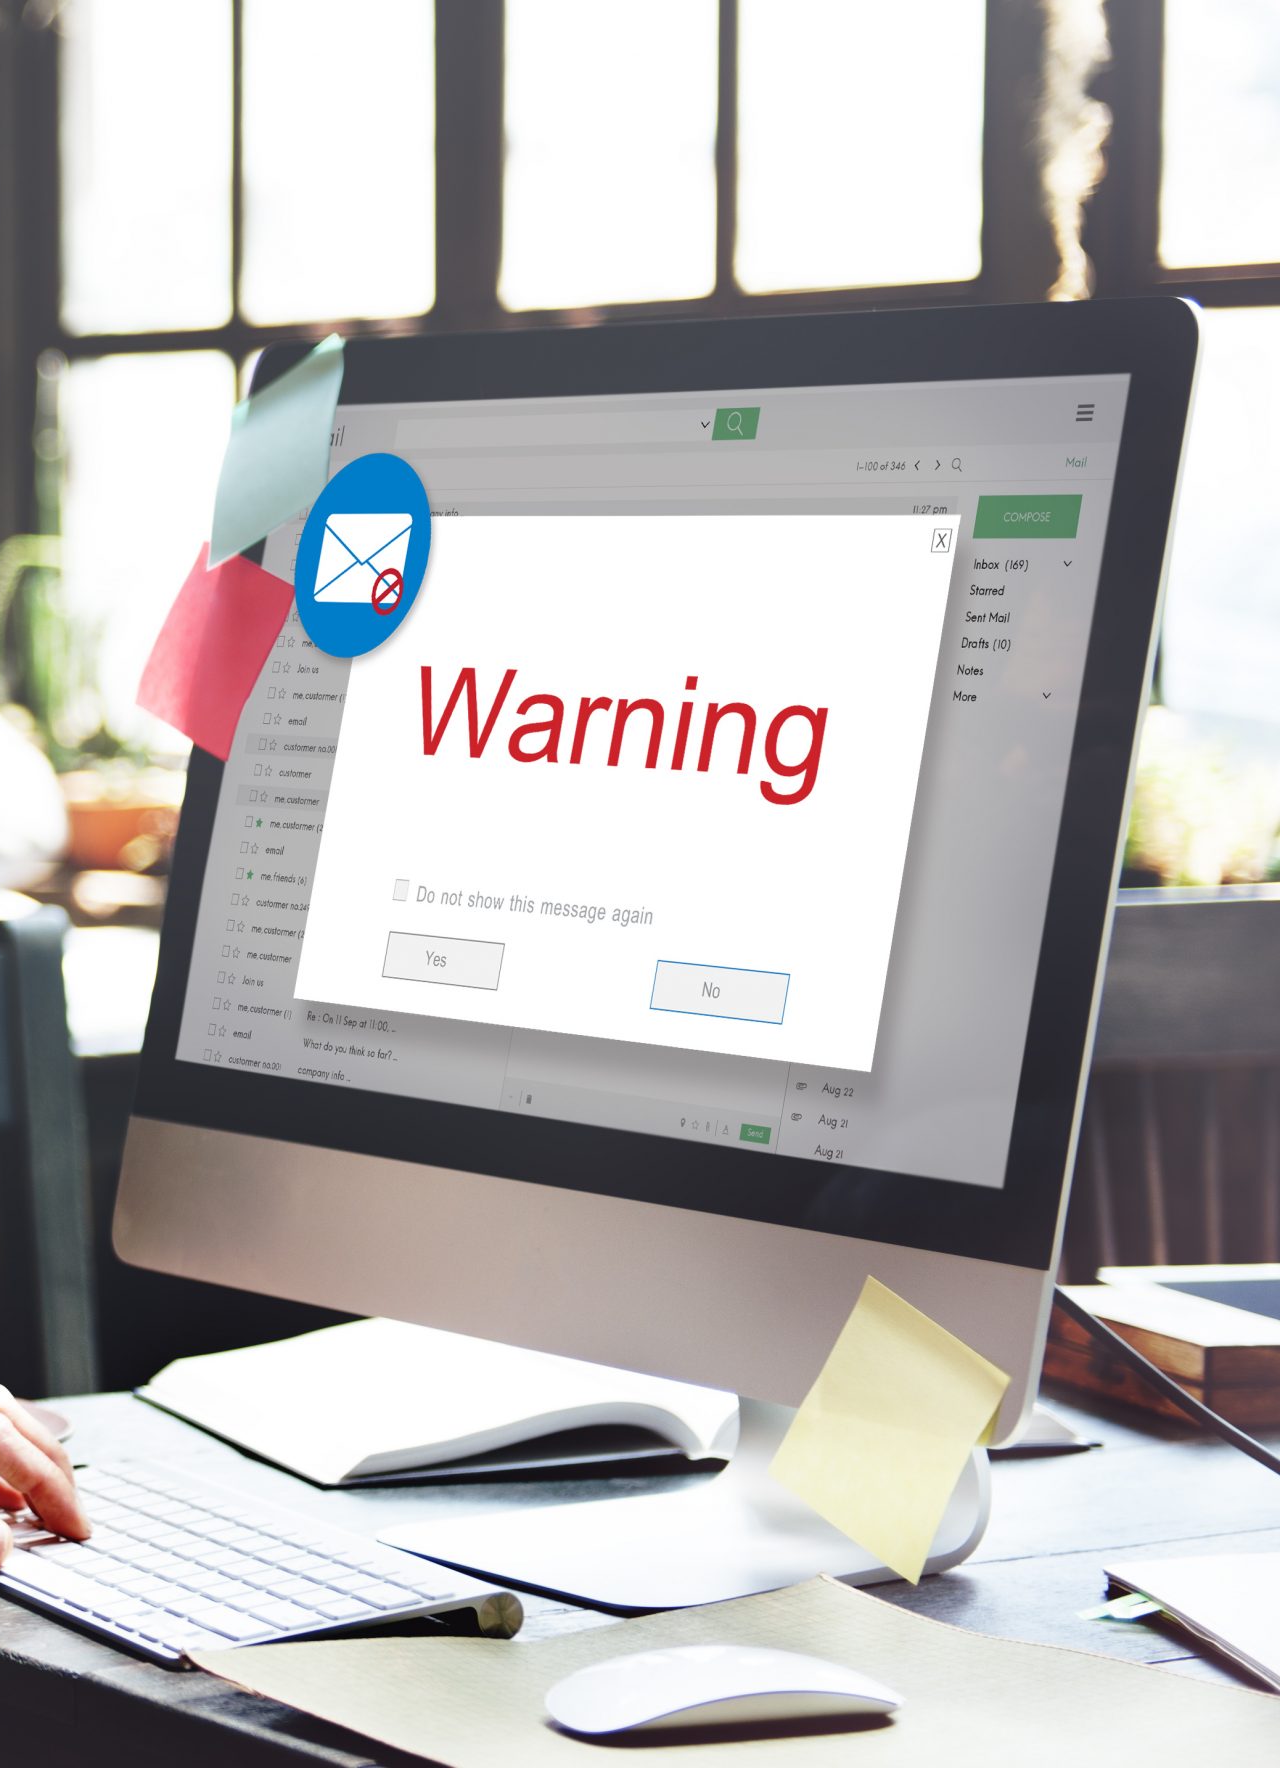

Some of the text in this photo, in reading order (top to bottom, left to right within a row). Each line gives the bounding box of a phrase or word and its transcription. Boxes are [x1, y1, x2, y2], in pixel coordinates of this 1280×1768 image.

[880, 460, 889, 471] of
[890, 461, 906, 471] 346
[1065, 456, 1088, 468] Mail
[913, 505, 948, 516] 11:27 pm
[1003, 511, 1051, 523] COMPOSE
[935, 532, 947, 549] X
[973, 558, 1029, 573] Inbox (169)
[969, 584, 1006, 596] Starred
[965, 611, 1011, 624] Sent Mail
[961, 636, 1012, 653] Drafts (10)
[297, 663, 320, 674] Join us
[956, 664, 984, 676] Notes
[952, 690, 977, 702] More
[288, 716, 308, 726] email
[420, 665, 829, 805] Warning
[265, 846, 285, 856] email
[297, 876, 307, 886] (6)
[416, 885, 654, 928] Do not show this message again
[425, 949, 448, 969] Yes
[241, 975, 264, 987] Join us
[701, 981, 721, 1000] No
[306, 1010, 316, 1021] Re
[322, 1013, 334, 1025] On
[335, 1014, 342, 1025] 11
[343, 1015, 358, 1029] Sep
[359, 1019, 368, 1029] at
[232, 1030, 253, 1040] email
[303, 1038, 322, 1050] What
[323, 1041, 333, 1052] do
[334, 1045, 347, 1055] you
[348, 1045, 366, 1057] think
[366, 1050, 376, 1058] so
[377, 1048, 393, 1060] far?
[297, 1067, 330, 1080] company
[330, 1070, 345, 1081] info
[822, 1083, 854, 1098] Aug 22
[818, 1114, 849, 1130] Aug 21
[747, 1127, 764, 1139] Send
[814, 1145, 843, 1160] Aug 21
